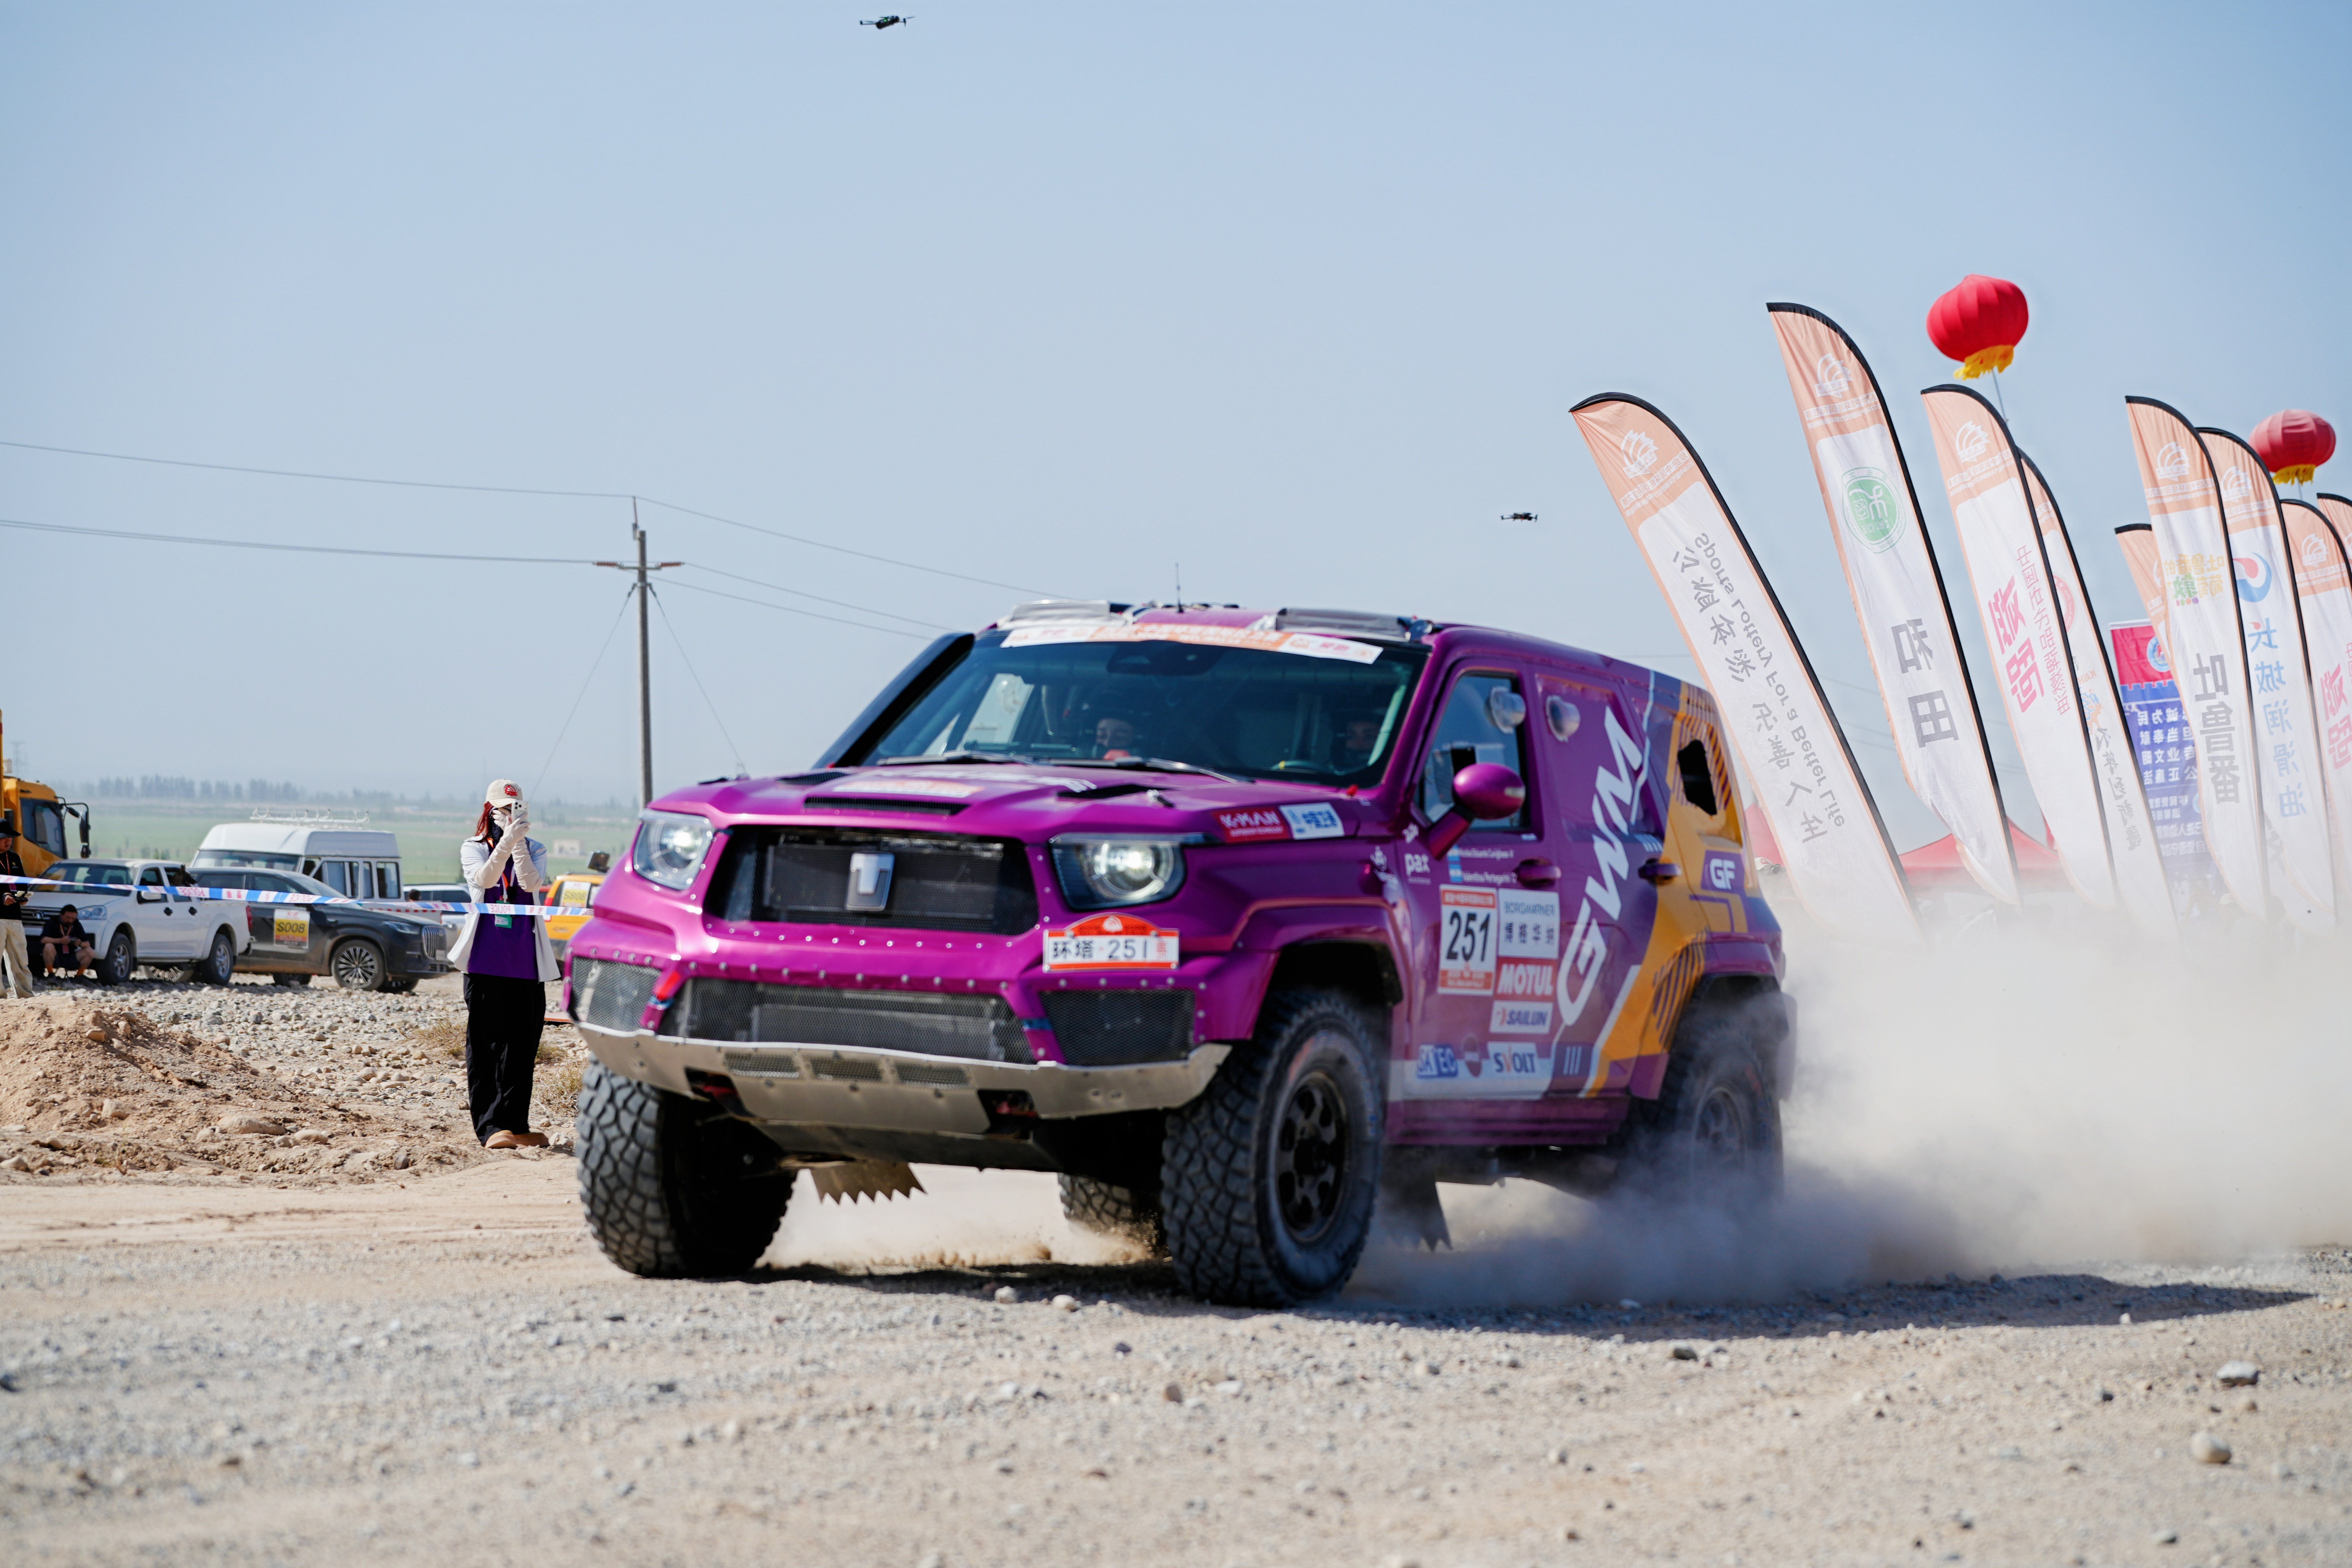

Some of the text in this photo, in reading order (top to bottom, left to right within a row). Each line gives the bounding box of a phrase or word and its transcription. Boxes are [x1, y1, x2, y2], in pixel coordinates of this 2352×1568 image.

[1557, 706, 1643, 1026] GWM
[1710, 858, 1736, 890] GF
[179, 887, 205, 897] POLICE
[289, 894, 314, 902] POLICE
[277, 922, 306, 933] S008
[1446, 910, 1492, 962] 251
[1497, 964, 1554, 996] MOTUL
[1506, 1009, 1548, 1026] SAILUN
[1494, 1045, 1536, 1074] SVOLT
